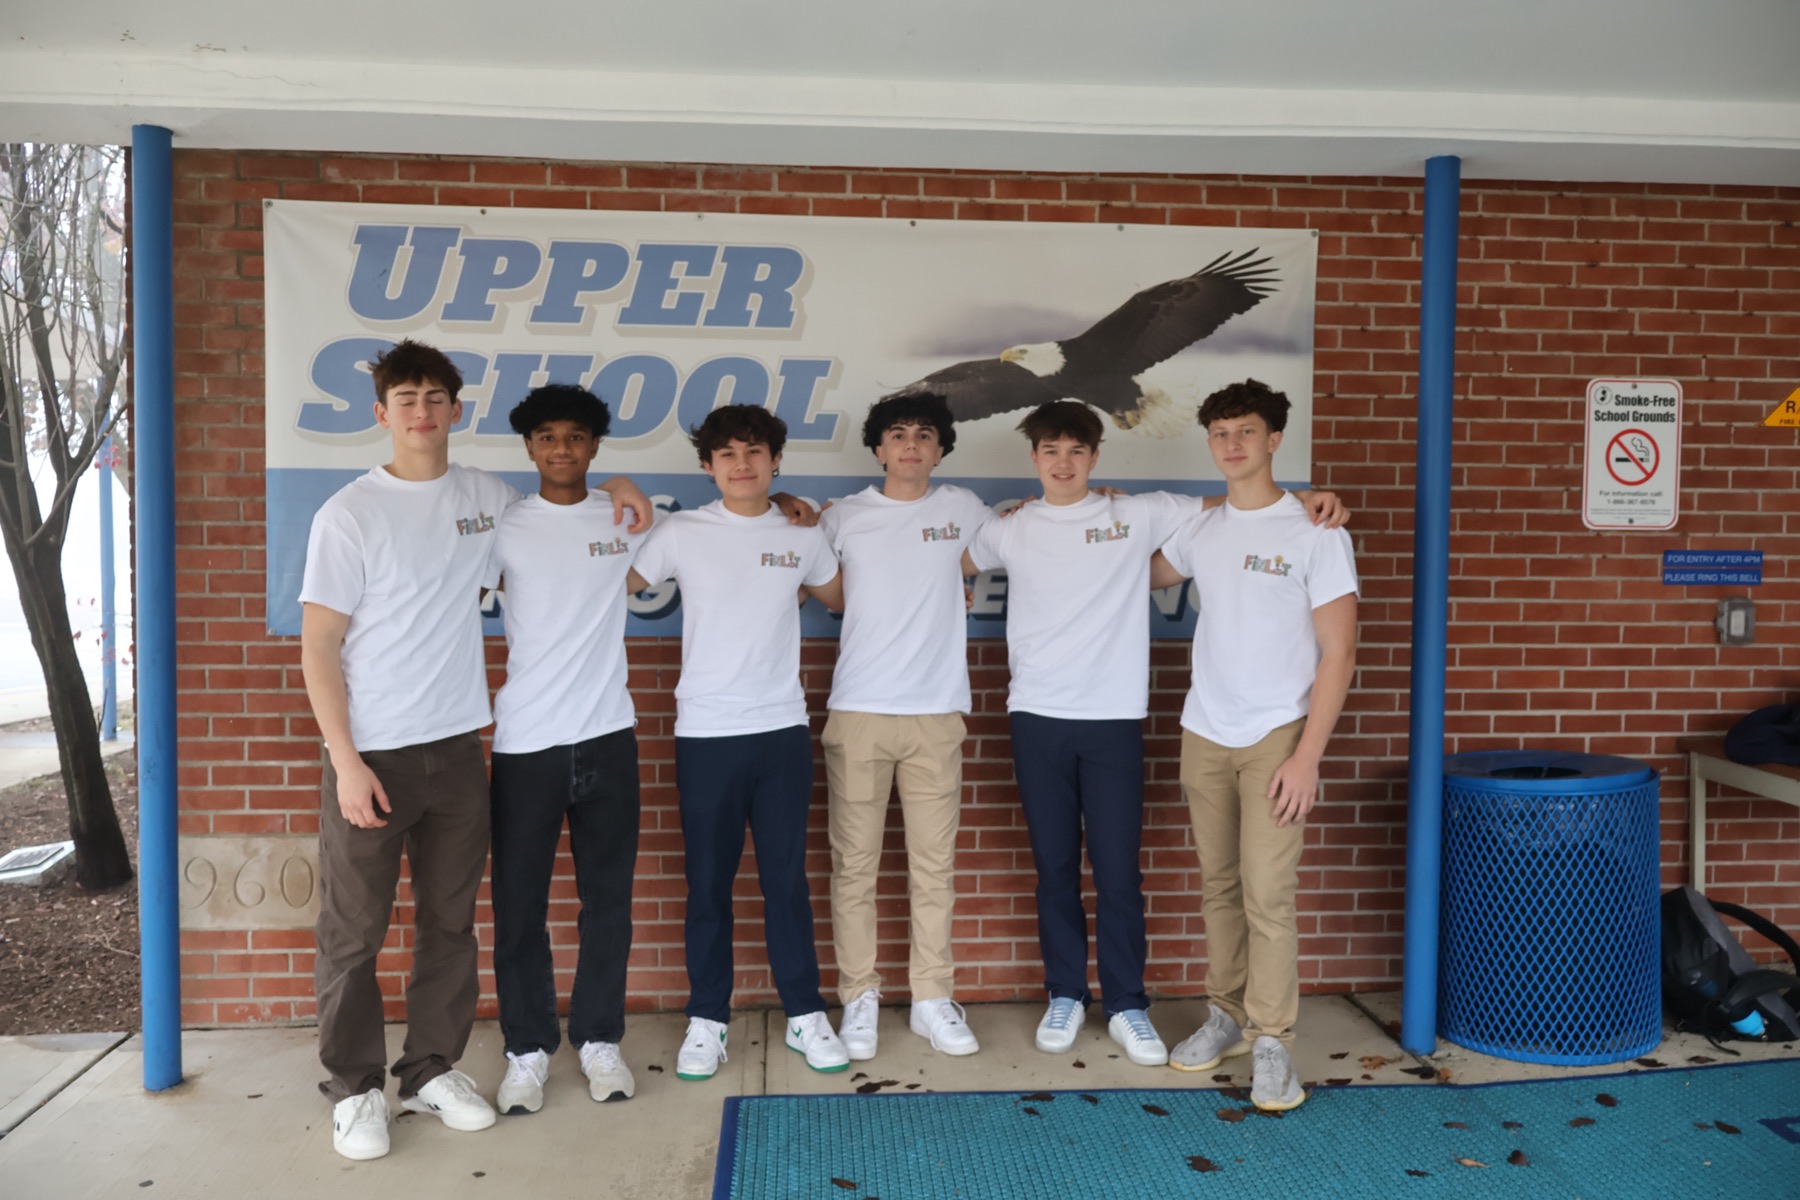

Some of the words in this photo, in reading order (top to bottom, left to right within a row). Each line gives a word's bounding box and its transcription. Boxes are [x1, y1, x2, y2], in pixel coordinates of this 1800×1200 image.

[347, 223, 807, 331] UPPER
[1614, 394, 1676, 407] Smoke-Free
[1594, 410, 1630, 422] School
[1632, 410, 1676, 423] Grounds
[1612, 490, 1648, 498] information
[1667, 555, 1685, 563] FOR
[1687, 555, 1715, 563] ENTRY
[1716, 555, 1742, 563] AFTER
[1665, 573, 1696, 582] PLEASE
[1697, 573, 1718, 582] RING
[1719, 573, 1738, 582] THIS
[1740, 573, 1758, 582] BELL
